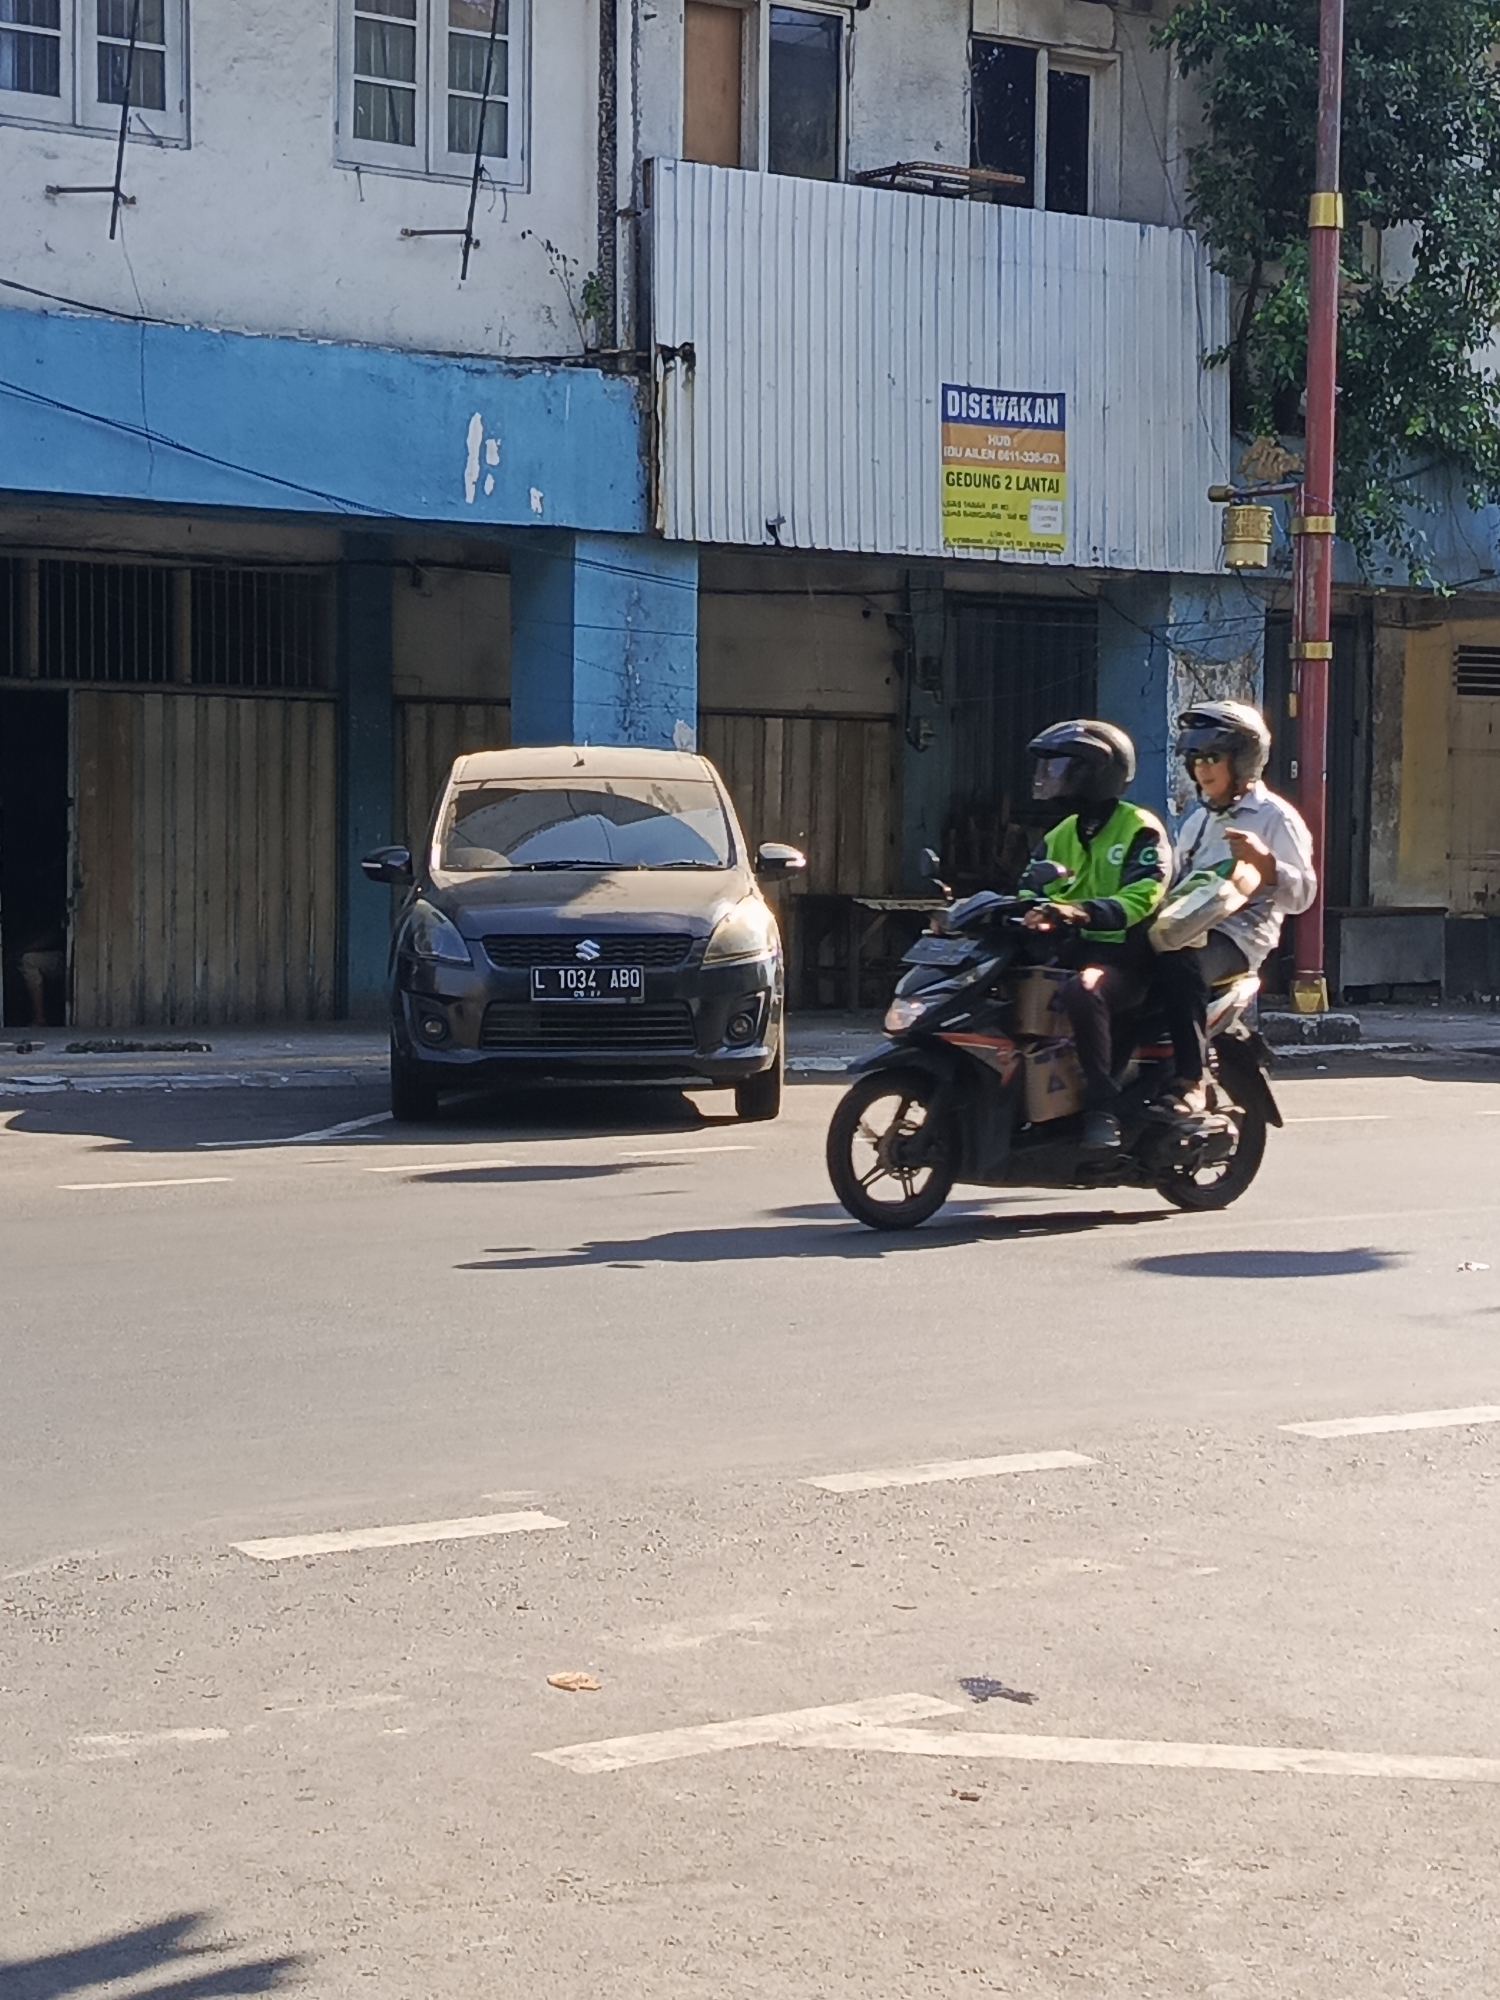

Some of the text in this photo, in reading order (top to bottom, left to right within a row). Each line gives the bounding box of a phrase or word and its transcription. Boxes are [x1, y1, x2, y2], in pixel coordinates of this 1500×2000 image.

[947, 390, 1059, 424] DISEWAKAN
[946, 471, 1060, 493] GEDUNG 2 LANTAI
[535, 969, 545, 989] L
[558, 969, 597, 989] 1034
